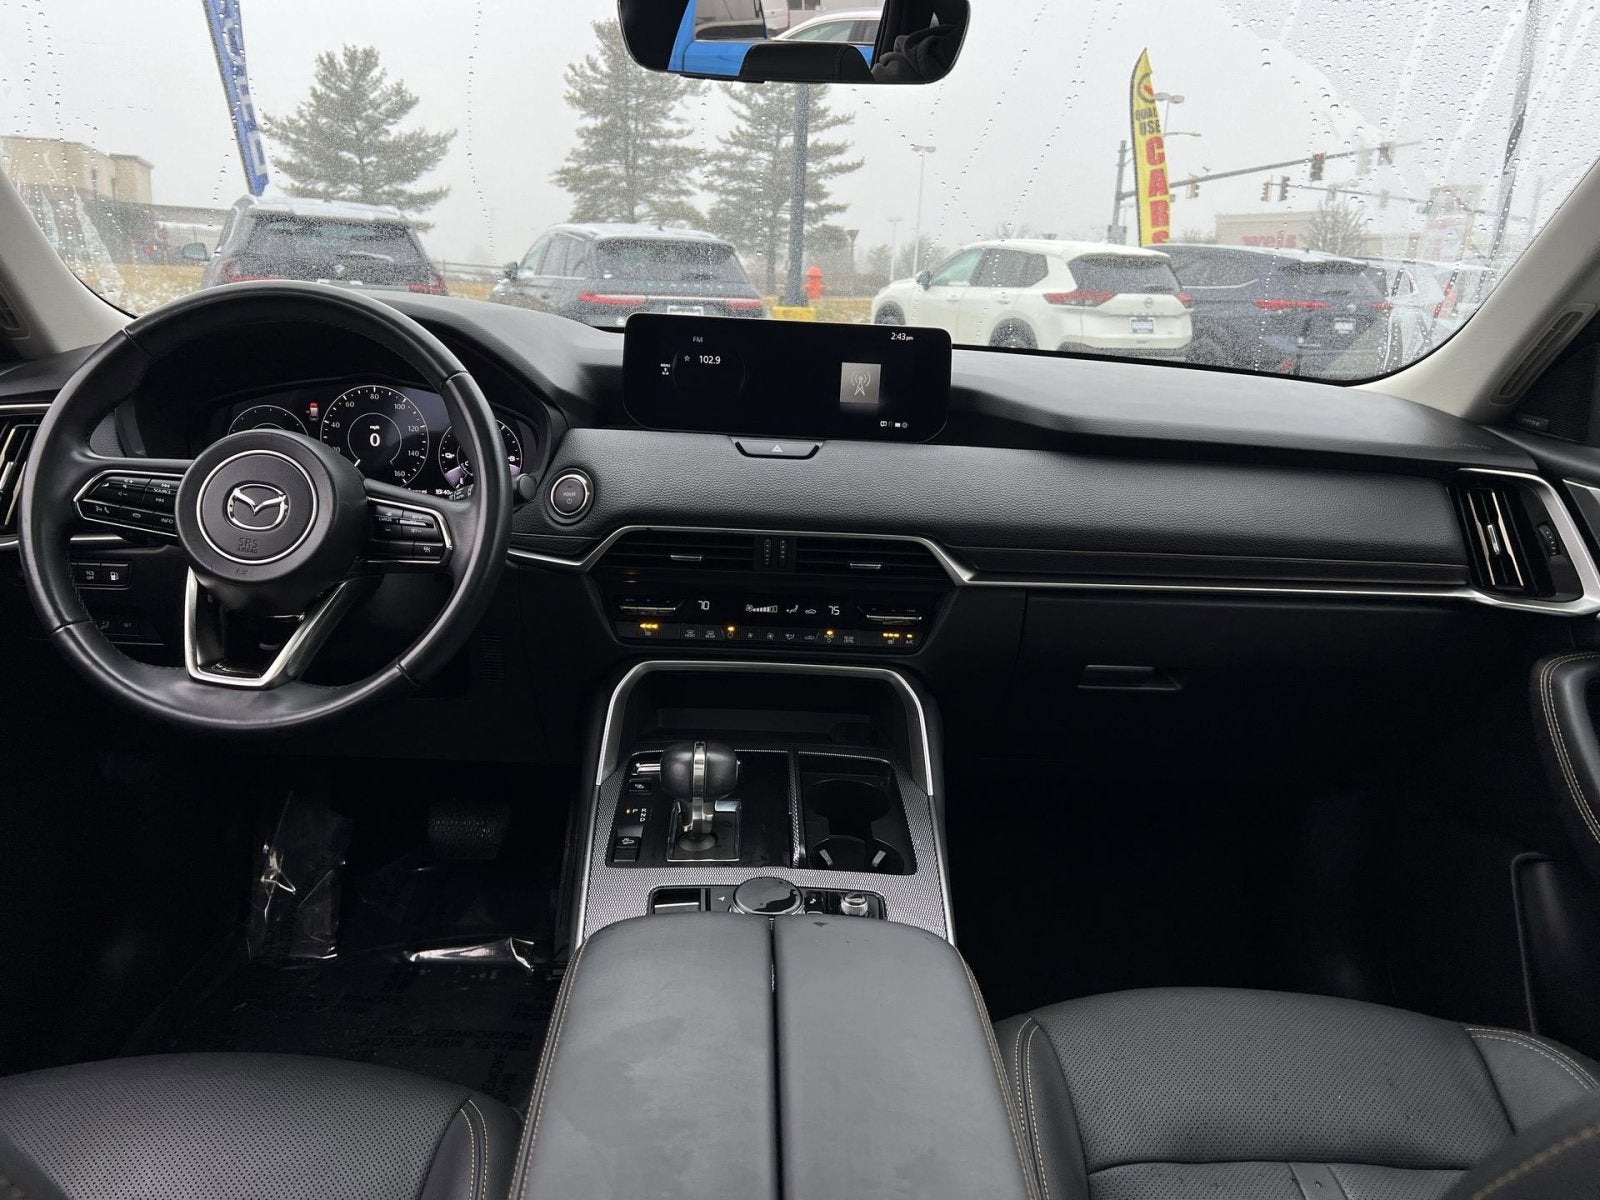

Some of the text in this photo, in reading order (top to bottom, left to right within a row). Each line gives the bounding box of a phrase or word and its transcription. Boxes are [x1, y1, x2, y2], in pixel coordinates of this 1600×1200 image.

[1145, 136, 1169, 244] CARS
[692, 335, 704, 343] FM
[699, 355, 721, 364] 102.9
[369, 433, 380, 447] 0
[238, 537, 258, 548] SRS
[698, 600, 710, 611] 70
[828, 605, 840, 616] 75
